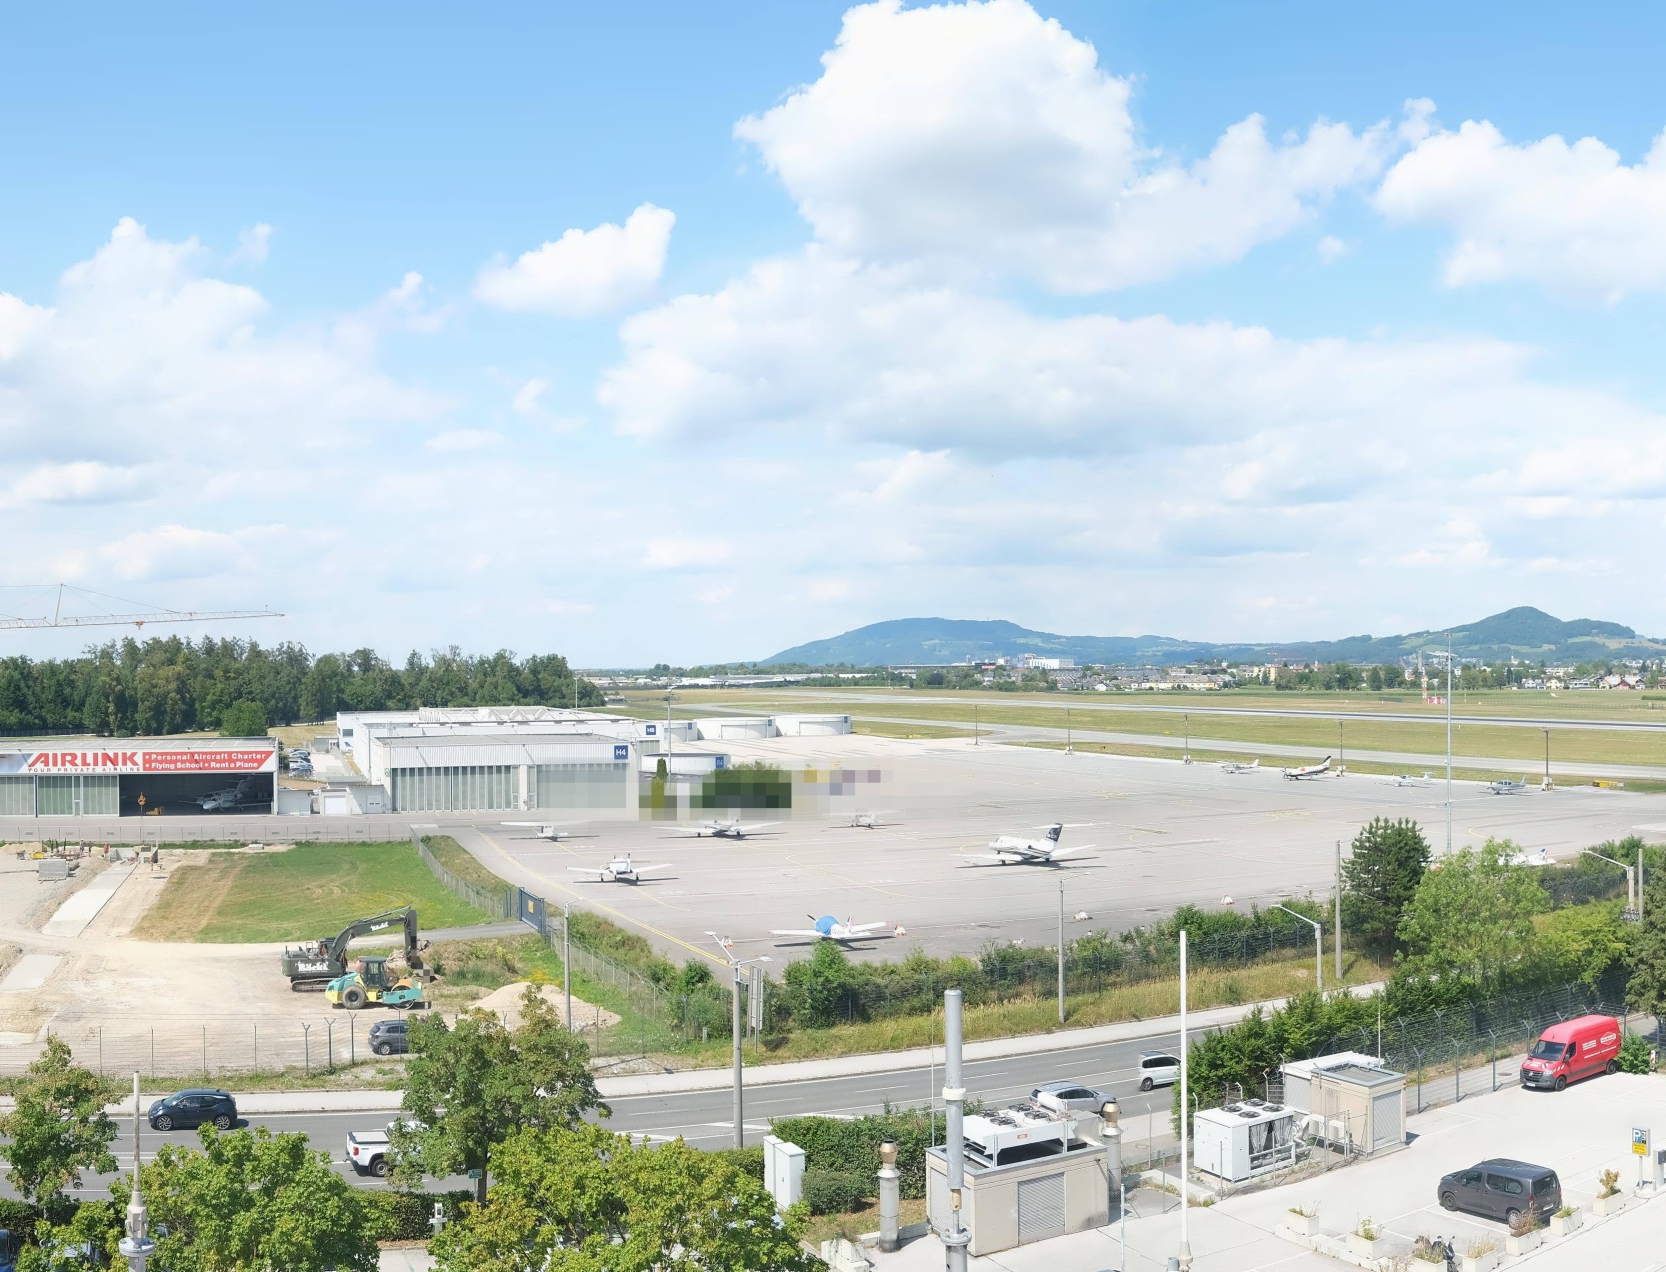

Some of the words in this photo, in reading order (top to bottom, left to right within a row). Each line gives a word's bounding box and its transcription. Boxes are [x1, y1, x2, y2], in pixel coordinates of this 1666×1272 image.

[231, 752, 266, 760] Charter
[615, 748, 626, 756] H4
[28, 752, 140, 767] AIRLINK
[151, 762, 175, 770] Flying
[176, 761, 202, 769] School
